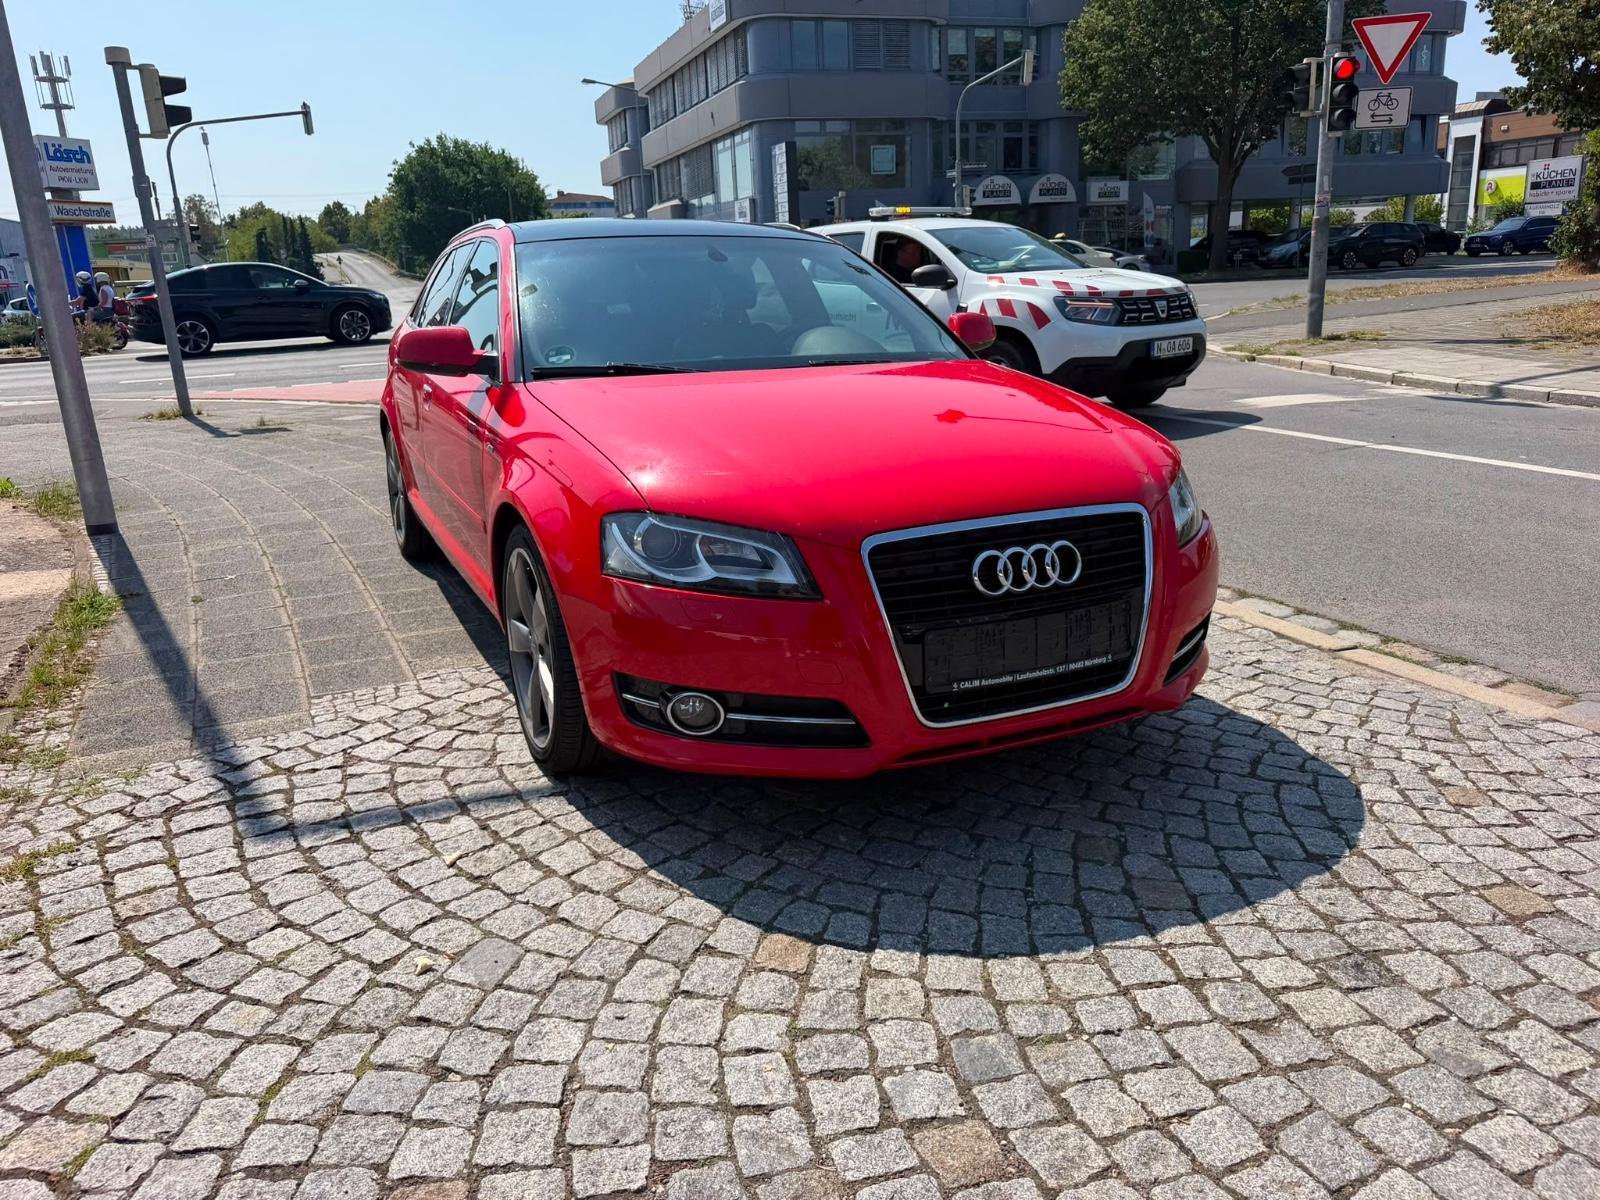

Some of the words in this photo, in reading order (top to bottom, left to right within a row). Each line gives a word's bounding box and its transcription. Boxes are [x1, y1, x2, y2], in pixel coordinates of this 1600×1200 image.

[44, 142, 91, 164] Lösch
[49, 165, 94, 175] Autovermietung
[1535, 164, 1577, 181] KÜCHEN
[1540, 178, 1575, 189] PLANER
[54, 205, 111, 218] Waschstraße
[1156, 342, 1162, 355] N
[1177, 338, 1191, 352] 606
[960, 680, 980, 689] CALIM
[981, 675, 1013, 686] Automobile
[1084, 657, 1107, 667] Nürnberg
